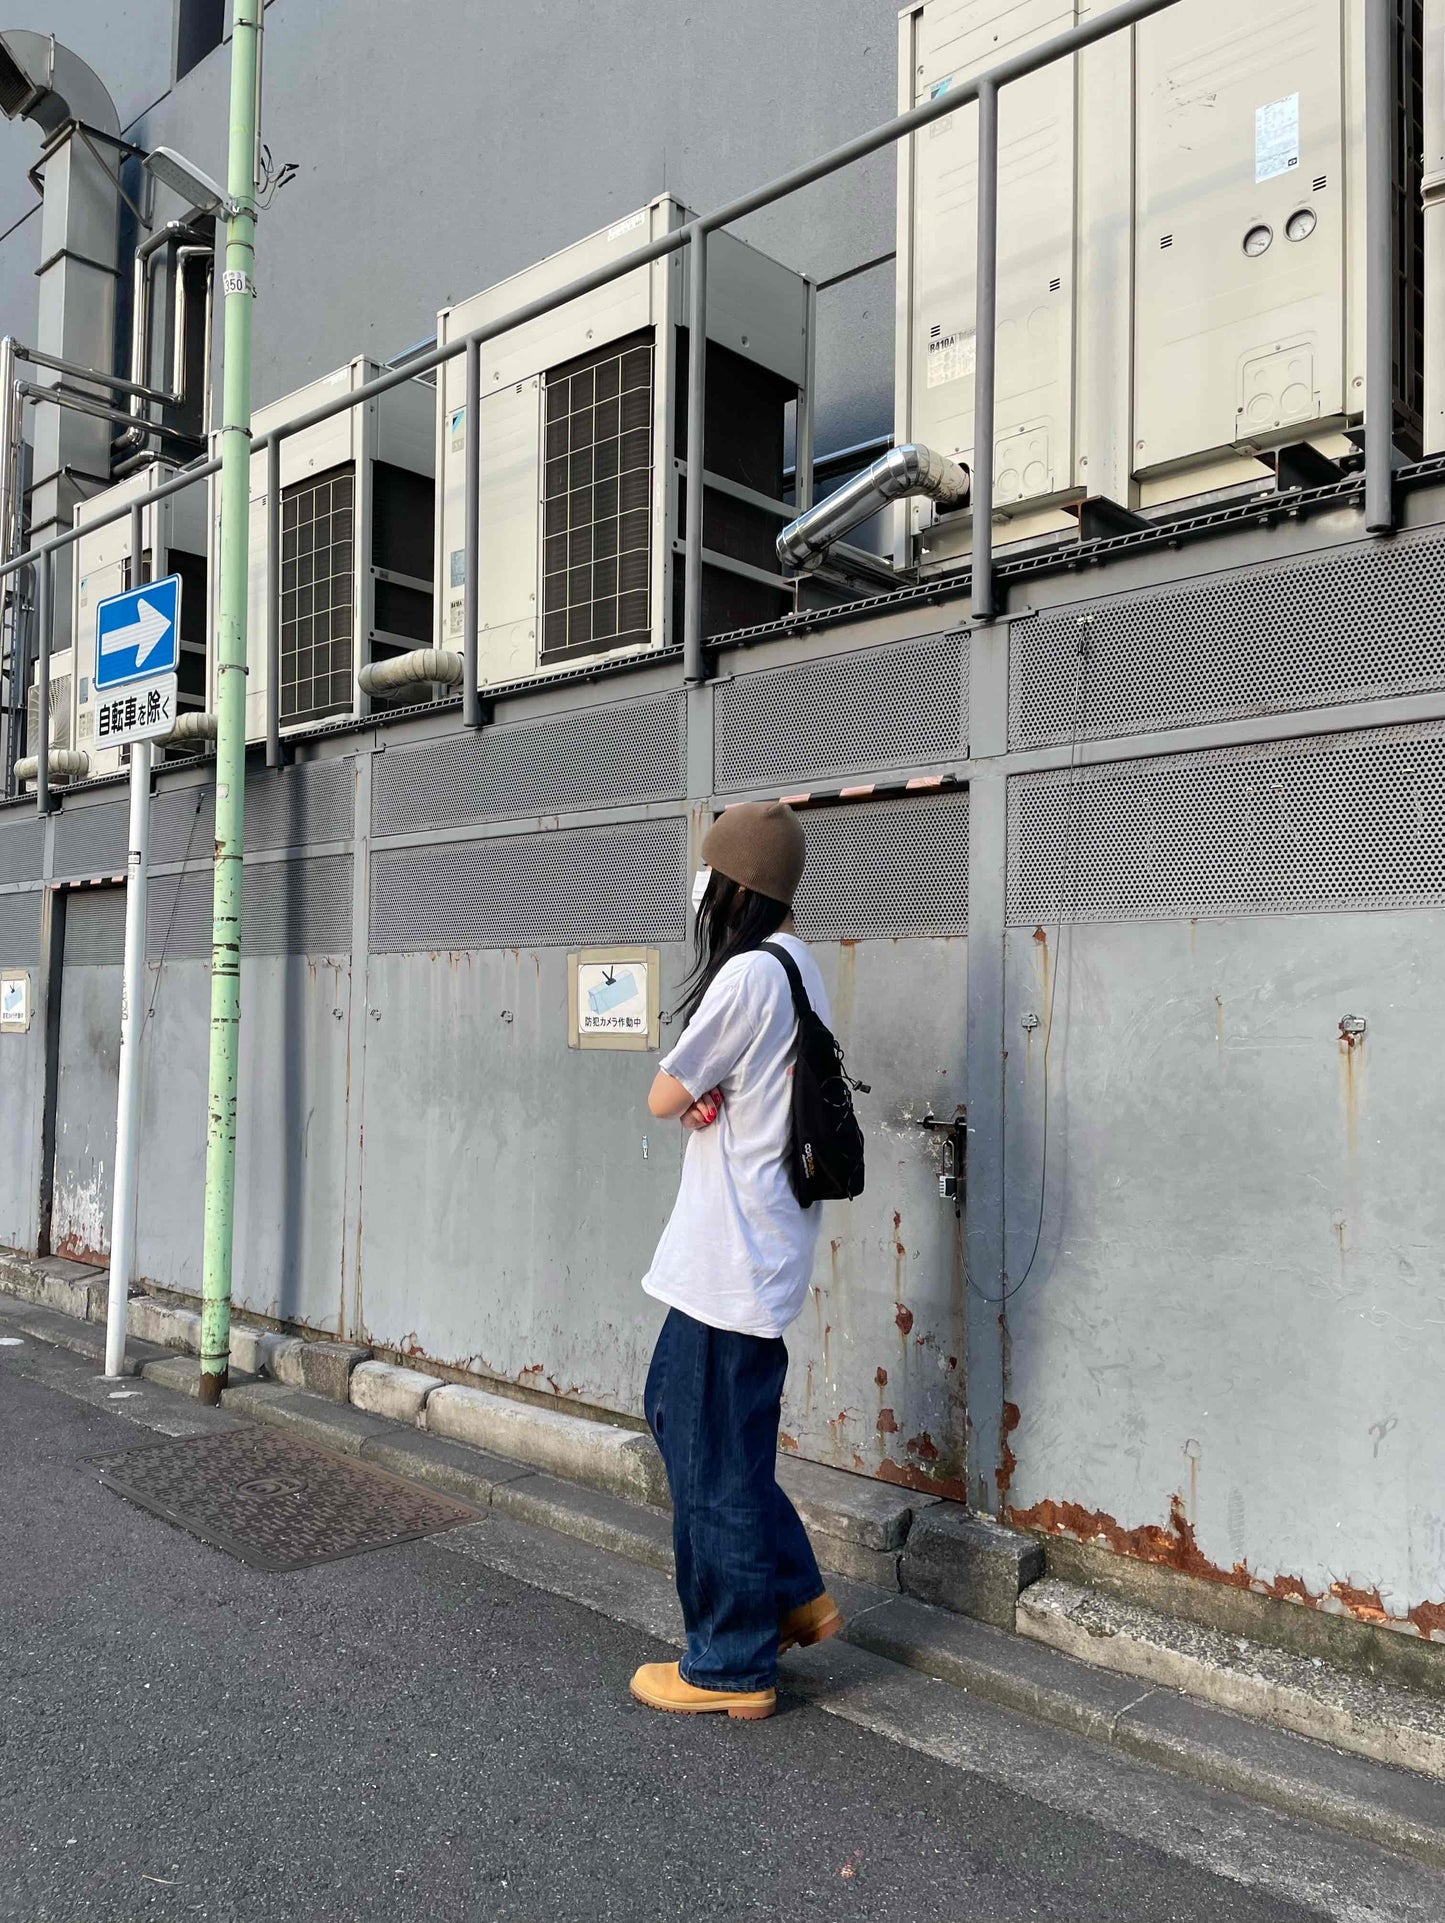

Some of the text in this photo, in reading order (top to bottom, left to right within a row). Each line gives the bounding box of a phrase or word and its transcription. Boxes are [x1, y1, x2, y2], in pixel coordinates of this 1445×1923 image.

[224, 278, 243, 292] 350
[929, 336, 955, 354] R410A
[99, 689, 170, 736] 自転車を除く
[584, 1016, 642, 1028] 防犯カメラ作動中
